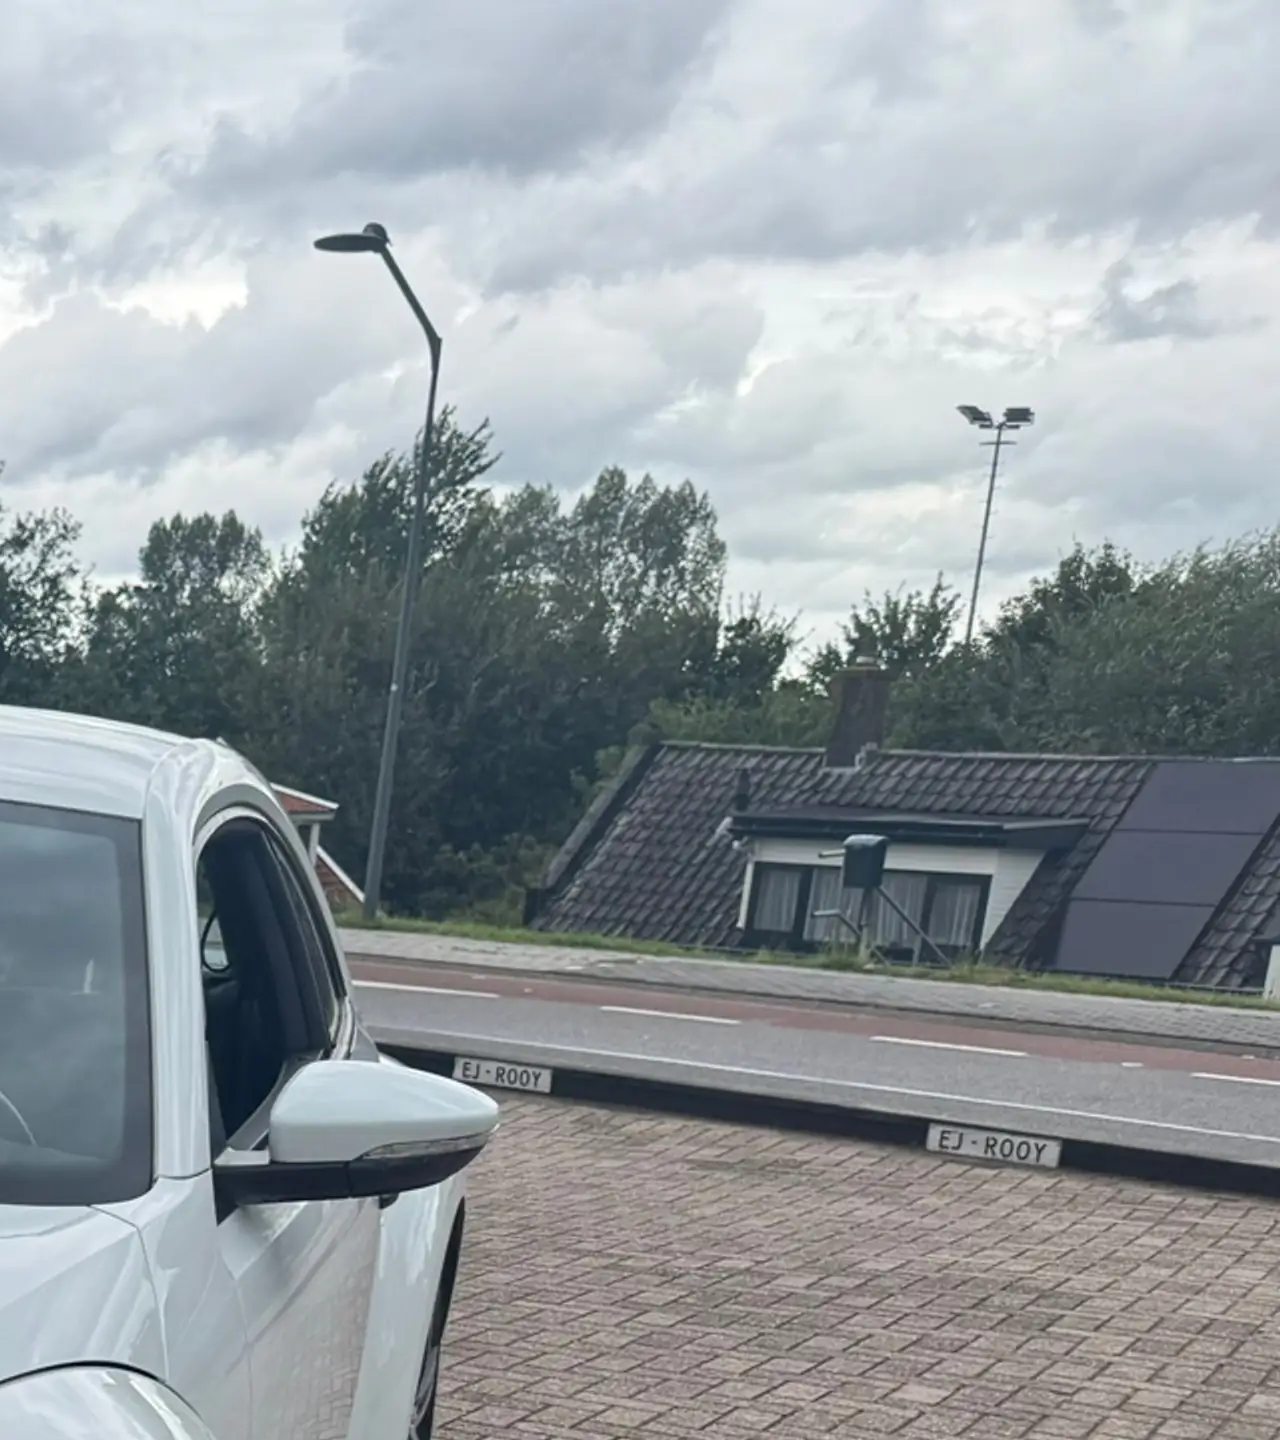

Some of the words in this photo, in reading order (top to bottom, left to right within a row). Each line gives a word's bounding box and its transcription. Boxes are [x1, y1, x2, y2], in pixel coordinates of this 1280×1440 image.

[461, 1061, 480, 1080] EJ
[495, 1065, 542, 1088] ROOY
[938, 1129, 964, 1151] EJ
[983, 1135, 1048, 1164] ROOY
